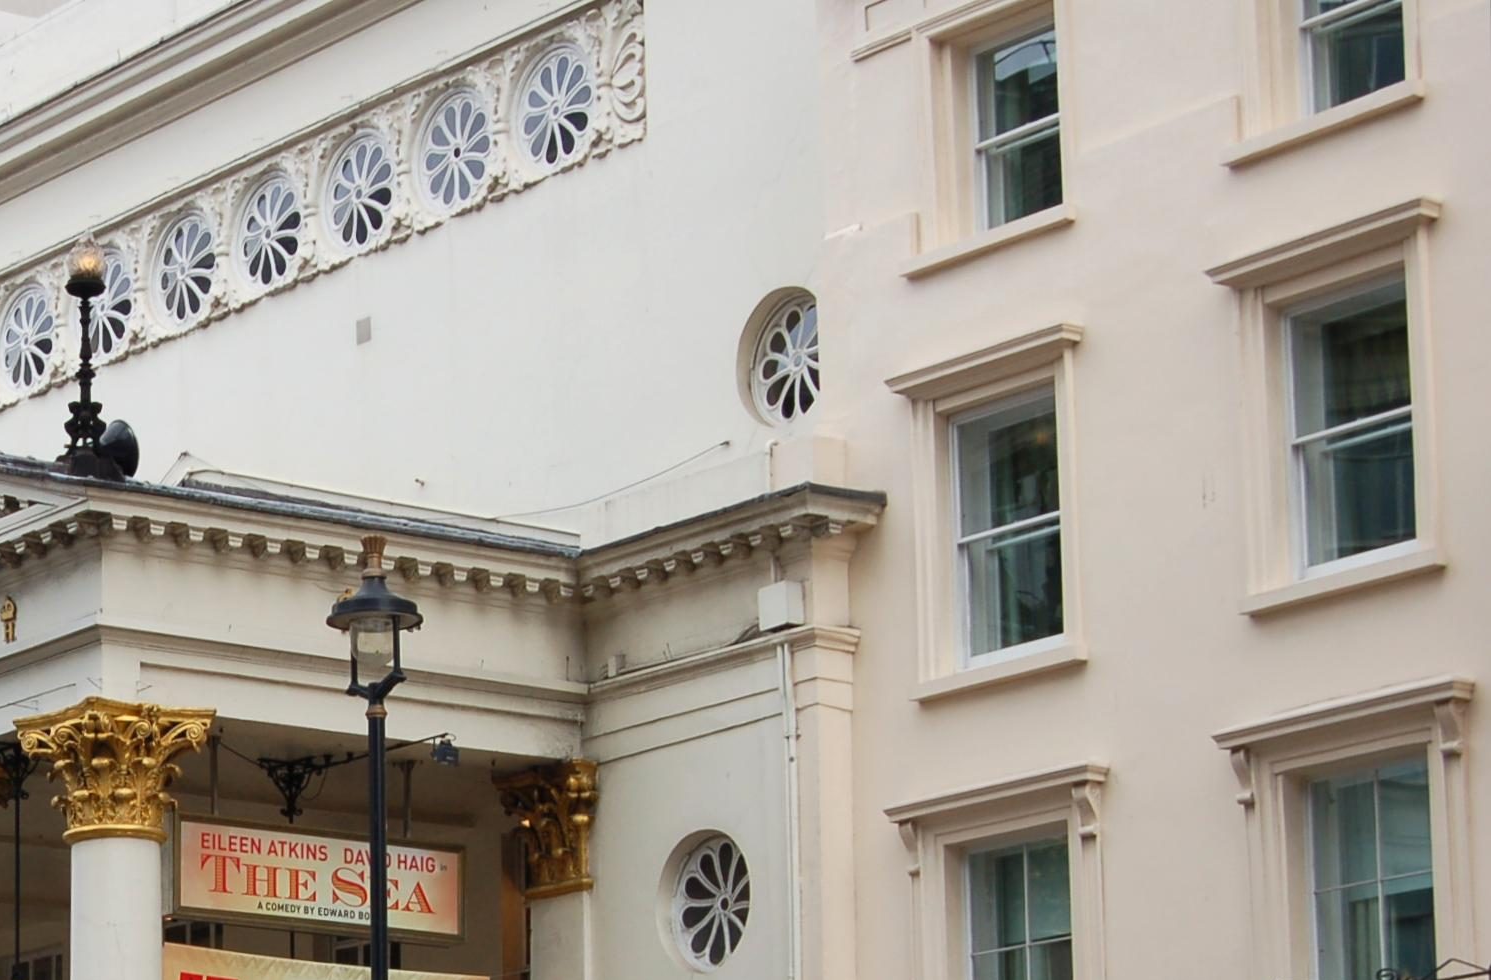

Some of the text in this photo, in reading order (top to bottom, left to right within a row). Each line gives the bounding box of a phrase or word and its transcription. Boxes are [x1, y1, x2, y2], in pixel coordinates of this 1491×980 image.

[200, 832, 262, 855] EILEEN
[267, 840, 329, 862] ATKINS
[344, 847, 391, 869] DAVD
[397, 853, 436, 873] HAIG
[200, 853, 317, 903] THE
[257, 901, 263, 910] A
[265, 902, 301, 914] COMEDY
[303, 906, 315, 915] BY
[317, 907, 356, 920] EDWARD
